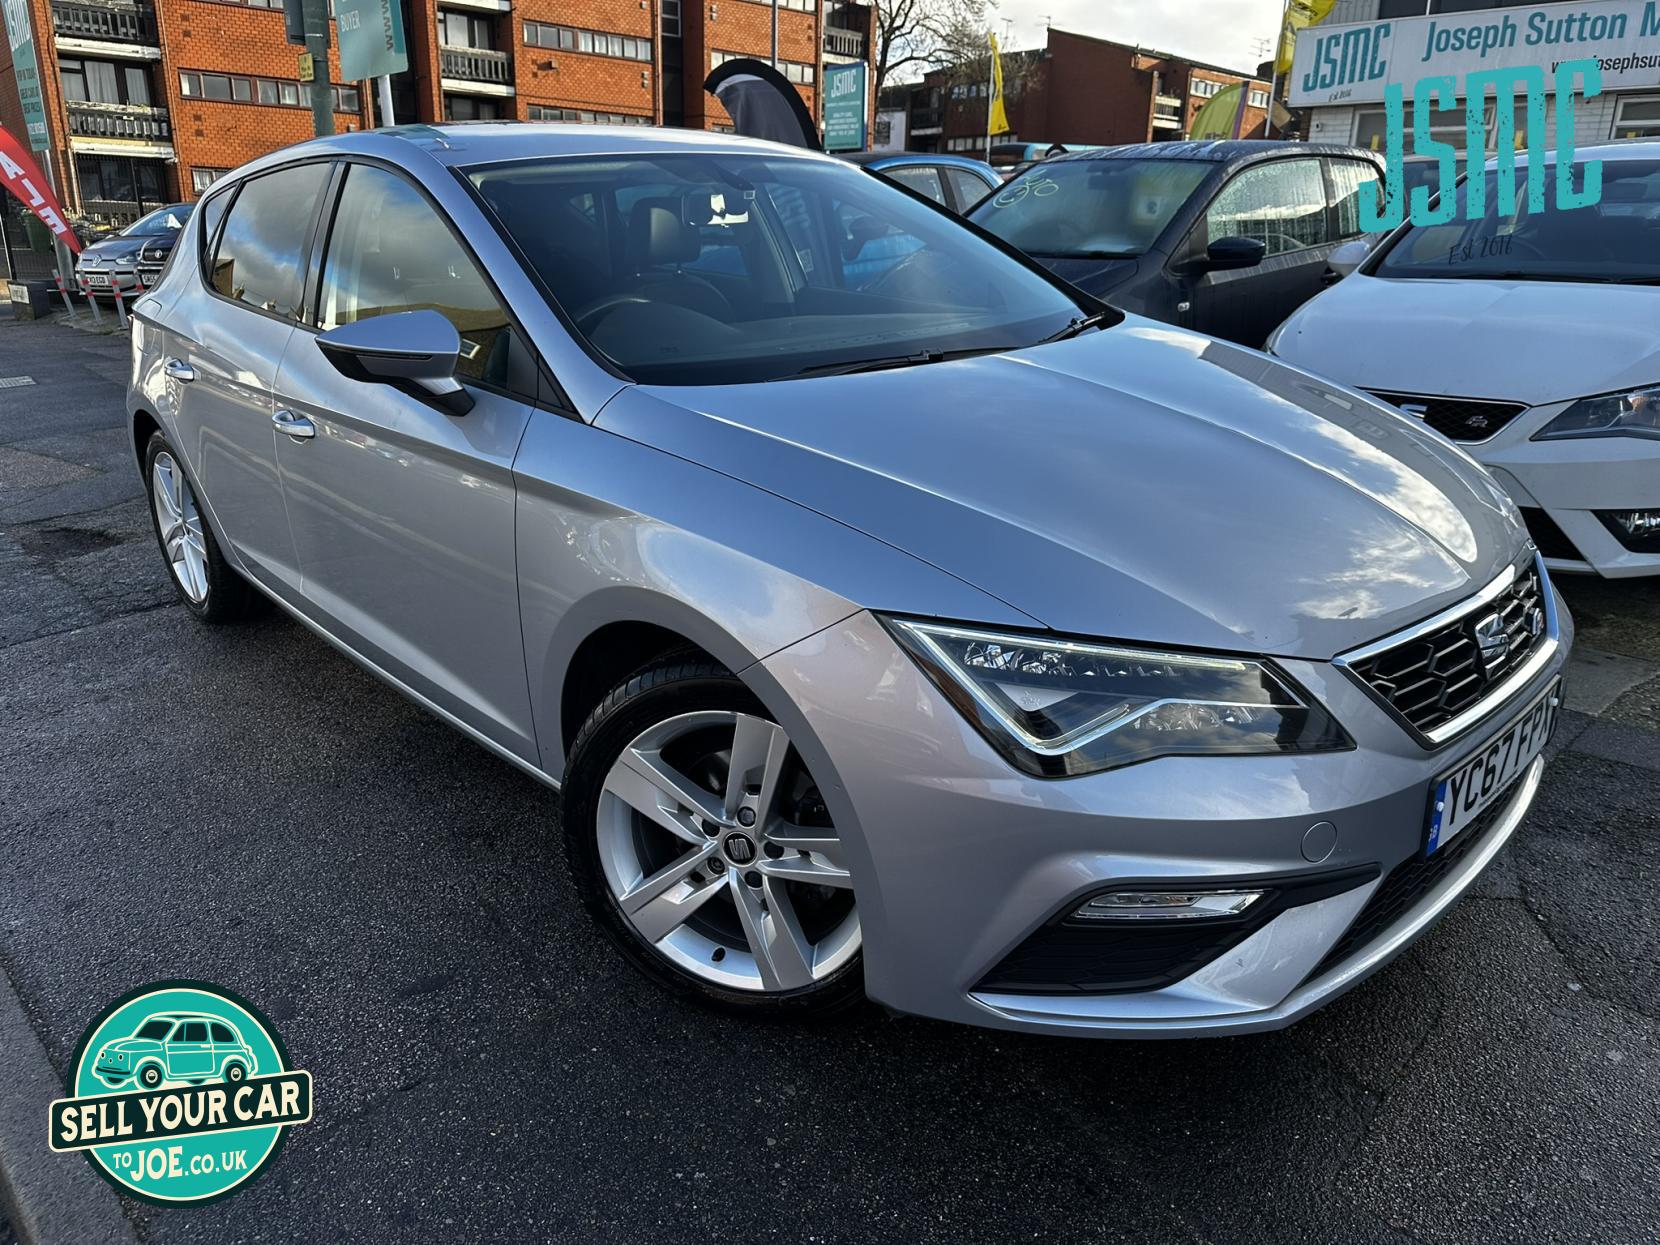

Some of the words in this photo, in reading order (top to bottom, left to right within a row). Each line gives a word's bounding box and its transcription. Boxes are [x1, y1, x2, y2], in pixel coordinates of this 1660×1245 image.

[341, 10, 360, 32] BUYER
[1422, 15, 1517, 62] Joseph
[1525, 11, 1627, 46] Sutton
[1302, 23, 1391, 92] JSMC
[831, 69, 857, 98] JSMC
[1449, 730, 1515, 825] YC67
